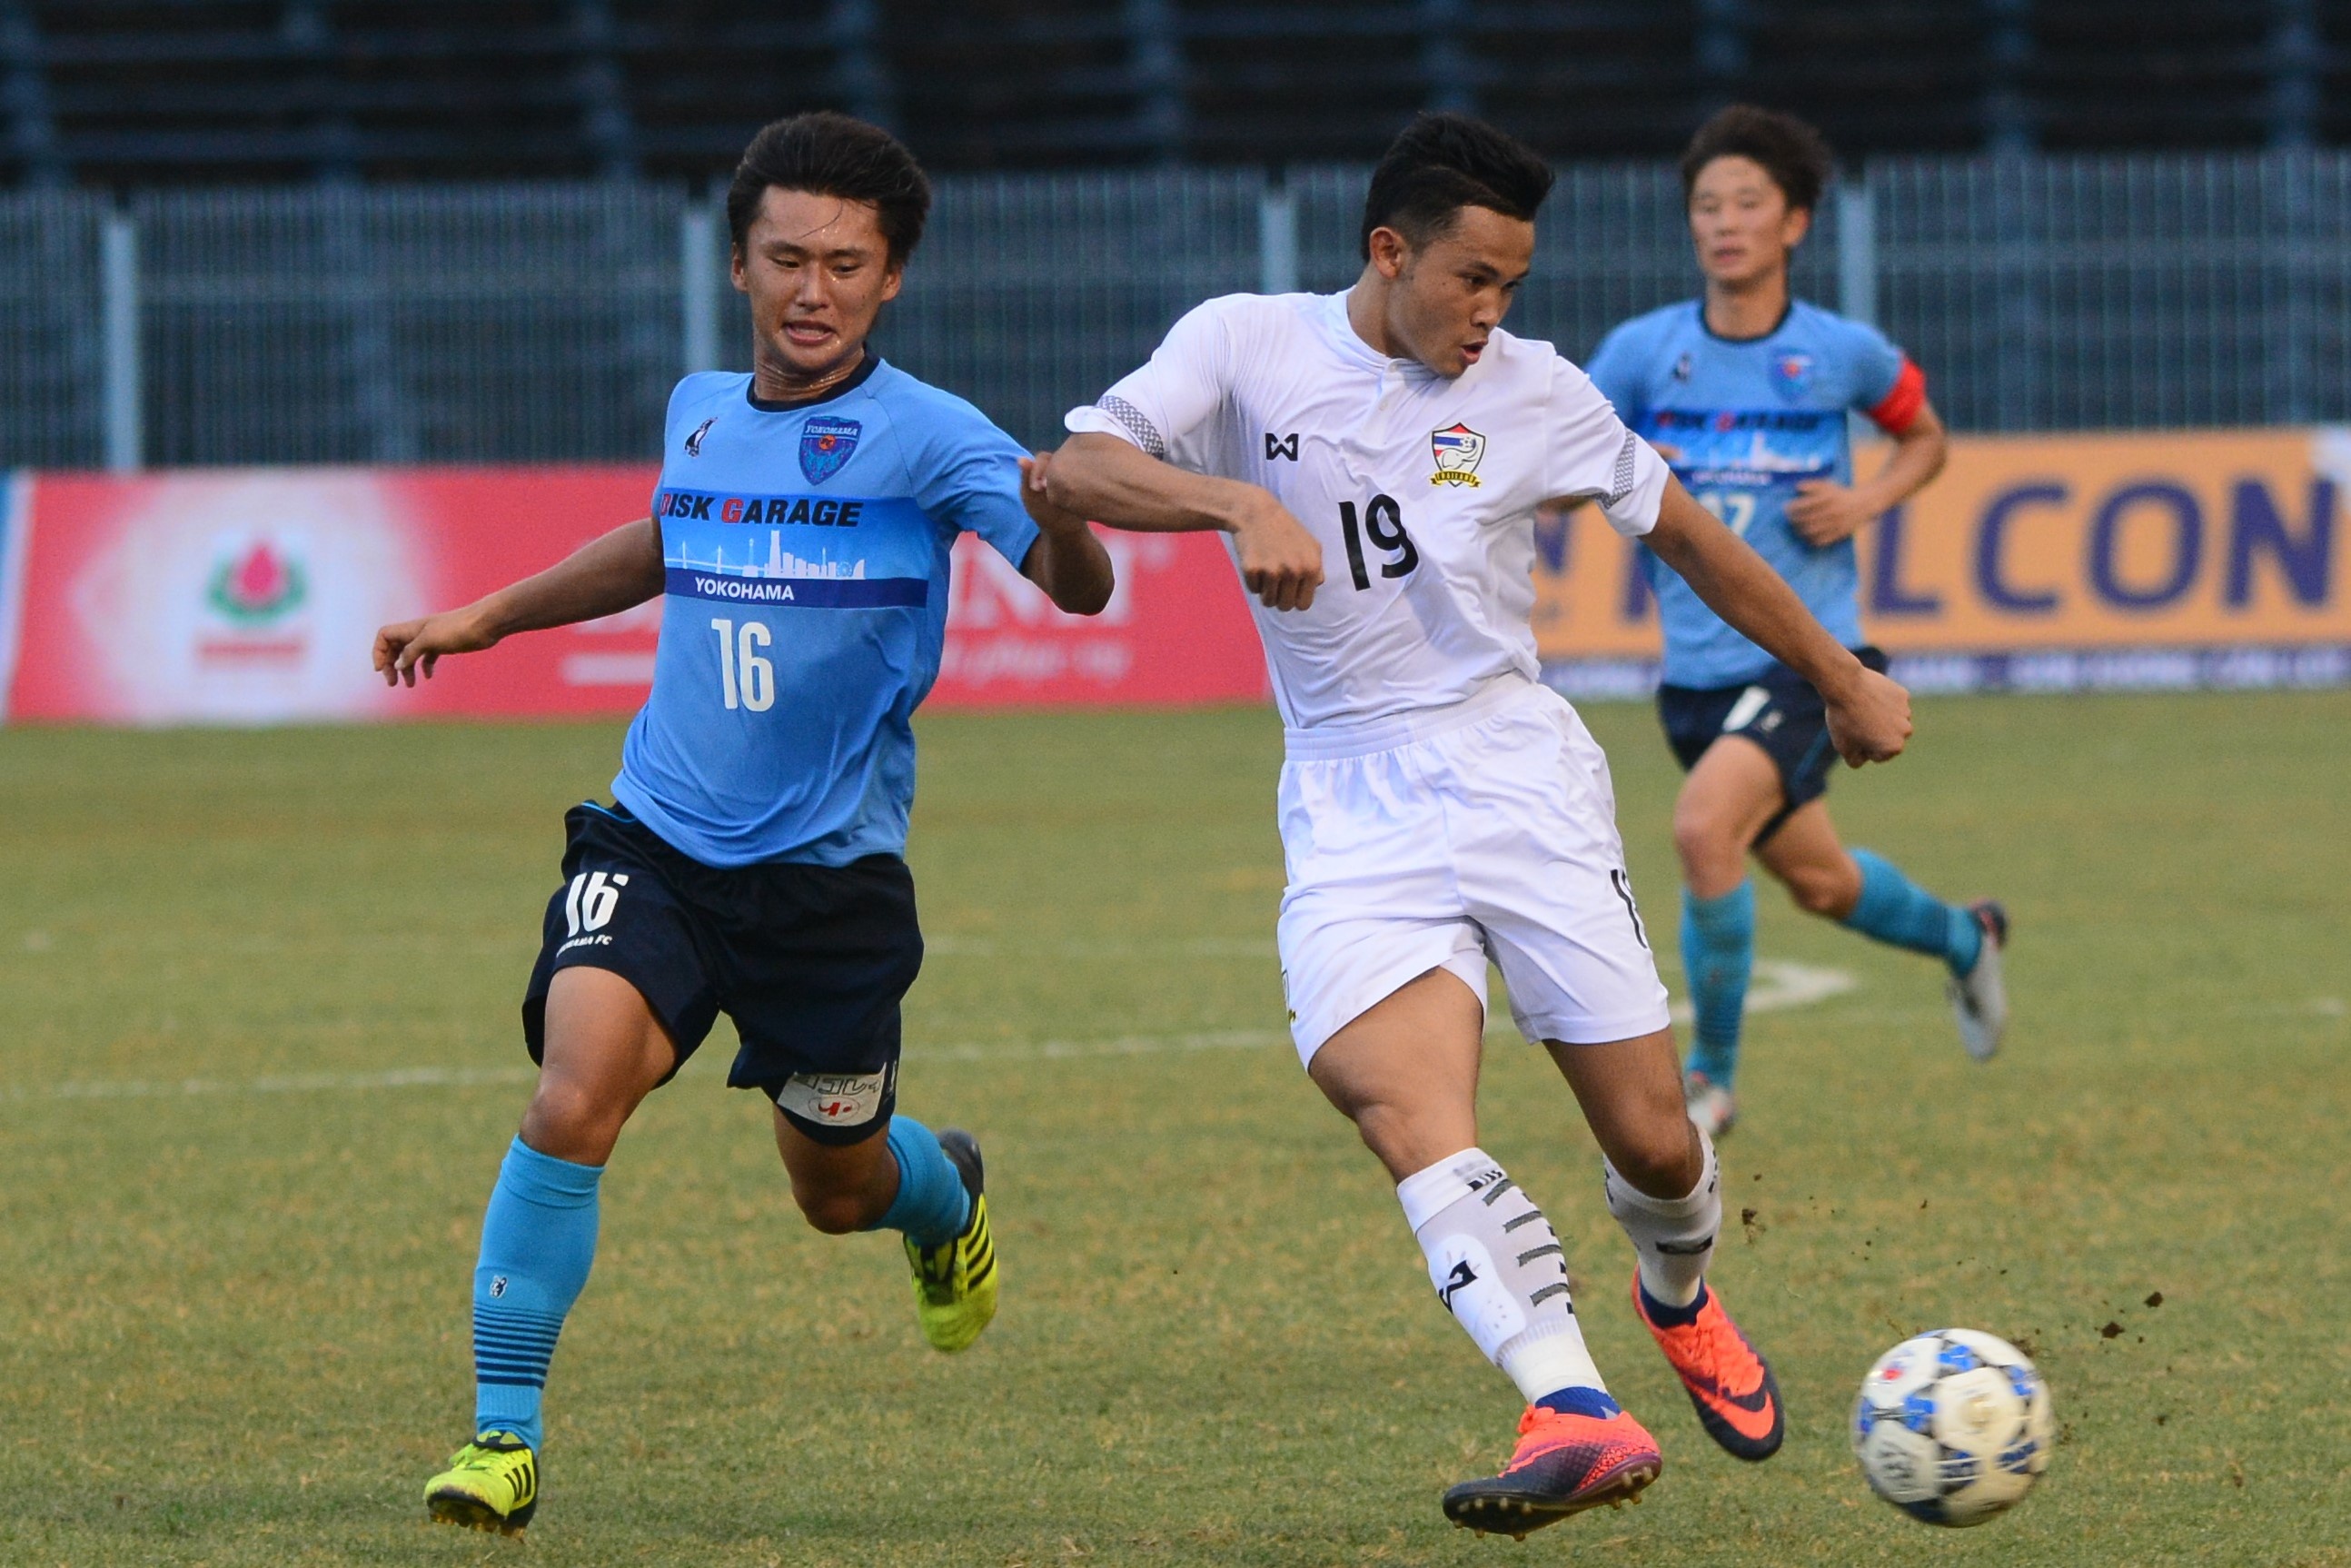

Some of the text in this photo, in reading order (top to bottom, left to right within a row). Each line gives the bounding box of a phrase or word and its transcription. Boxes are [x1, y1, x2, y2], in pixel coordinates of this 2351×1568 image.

[805, 424, 858, 436] YOKOHAMA
[660, 493, 863, 527] DISK GARAGE
[1338, 493, 1419, 591] 19
[695, 577, 795, 600] YOKOHAMA
[710, 618, 775, 712] 16
[565, 871, 629, 938] 16
